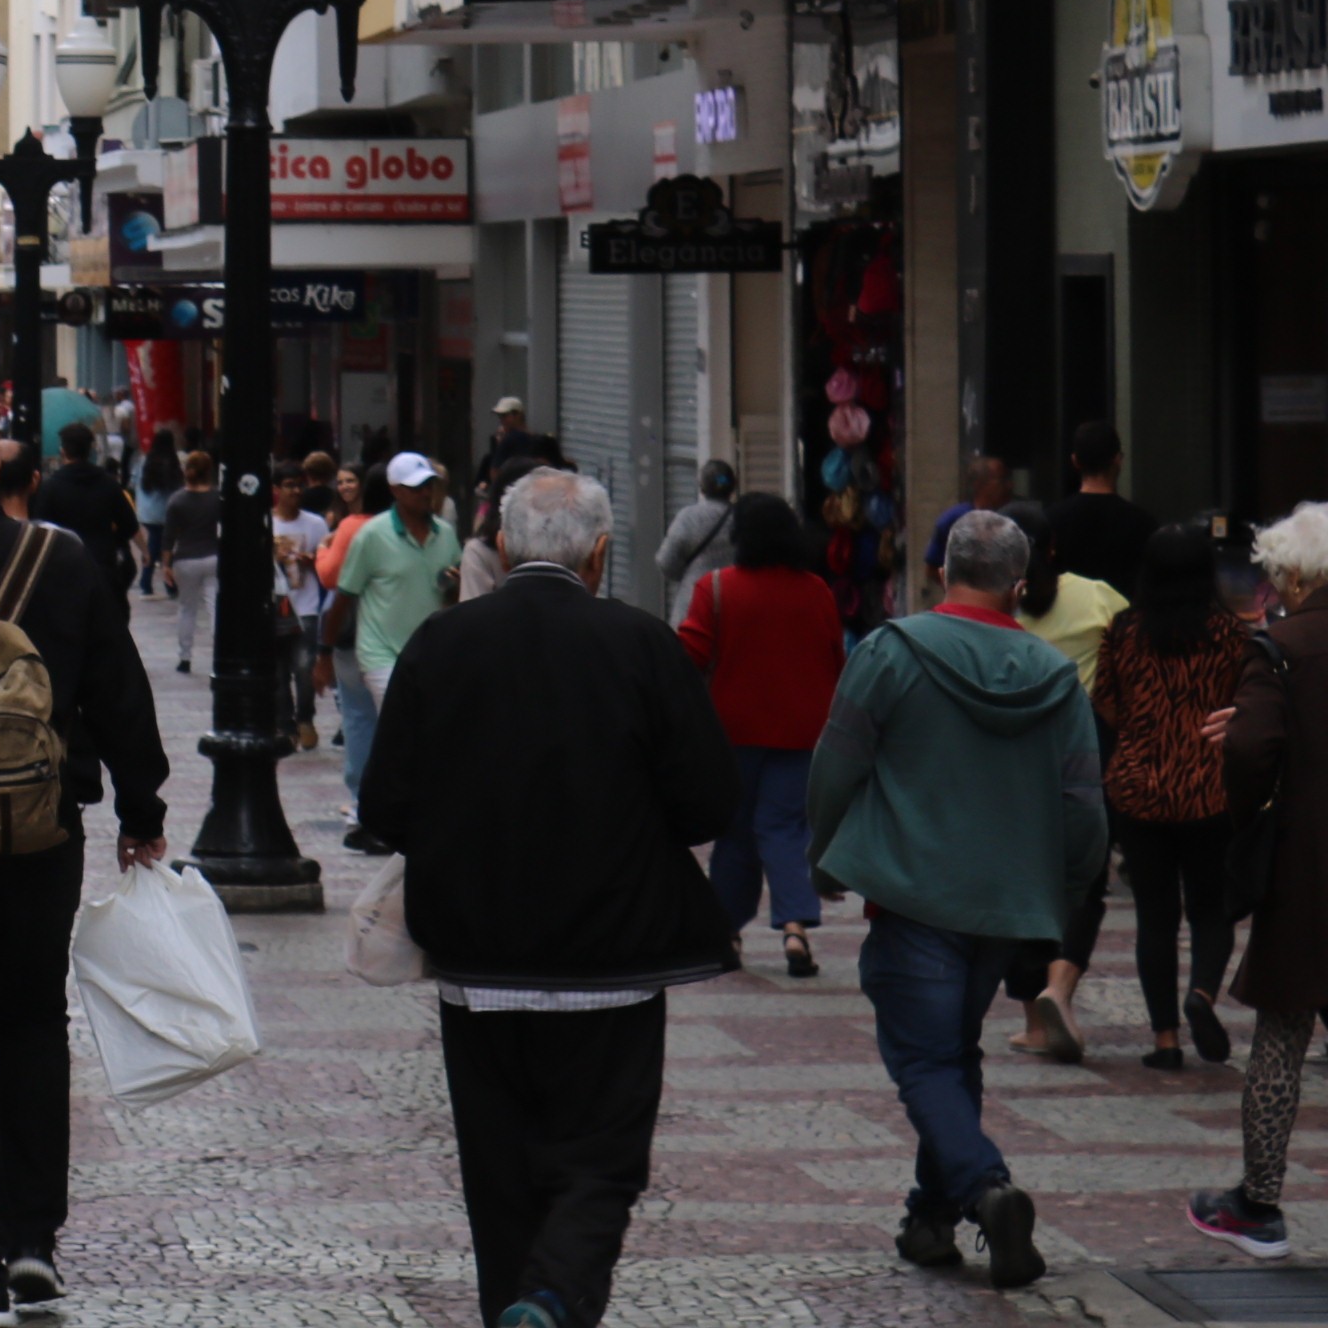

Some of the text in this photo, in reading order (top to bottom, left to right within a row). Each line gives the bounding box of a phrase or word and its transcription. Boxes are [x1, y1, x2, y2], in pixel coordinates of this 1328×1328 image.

[1107, 72, 1181, 143] BRASIL
[270, 143, 455, 189] tica globo
